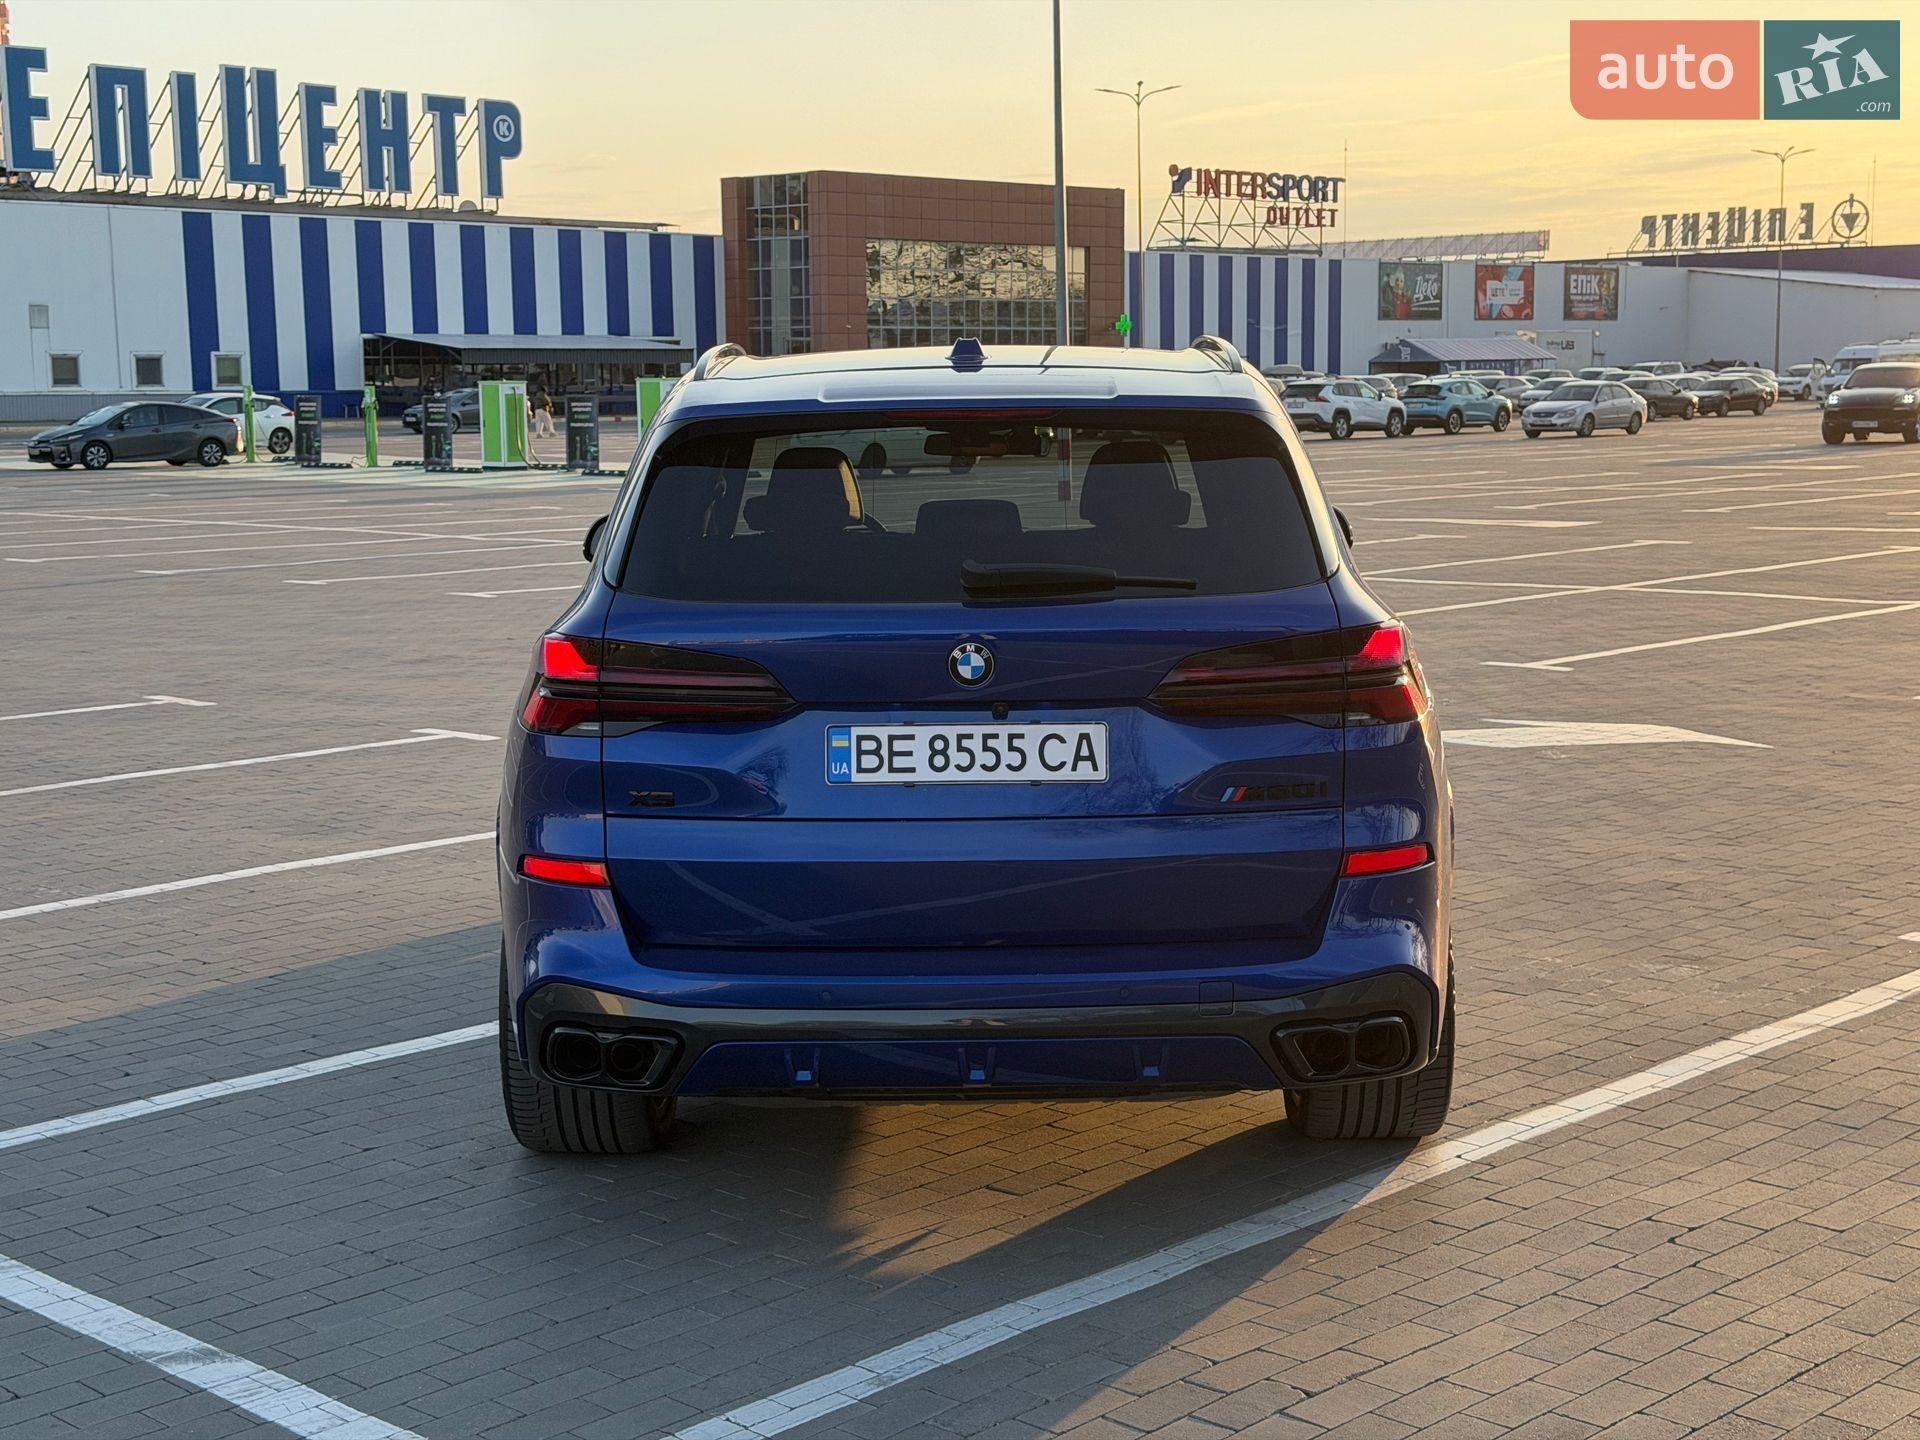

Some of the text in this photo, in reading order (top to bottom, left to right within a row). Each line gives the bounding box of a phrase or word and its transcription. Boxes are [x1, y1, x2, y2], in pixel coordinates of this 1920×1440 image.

[1, 45, 523, 199] ЕПІЦЕНТР
[1196, 167, 1346, 204] INTERSPORT
[1266, 206, 1338, 228] OUTLET
[952, 644, 991, 659] BMW
[856, 733, 1099, 773] BE 8555 CA
[832, 762, 849, 774] UA
